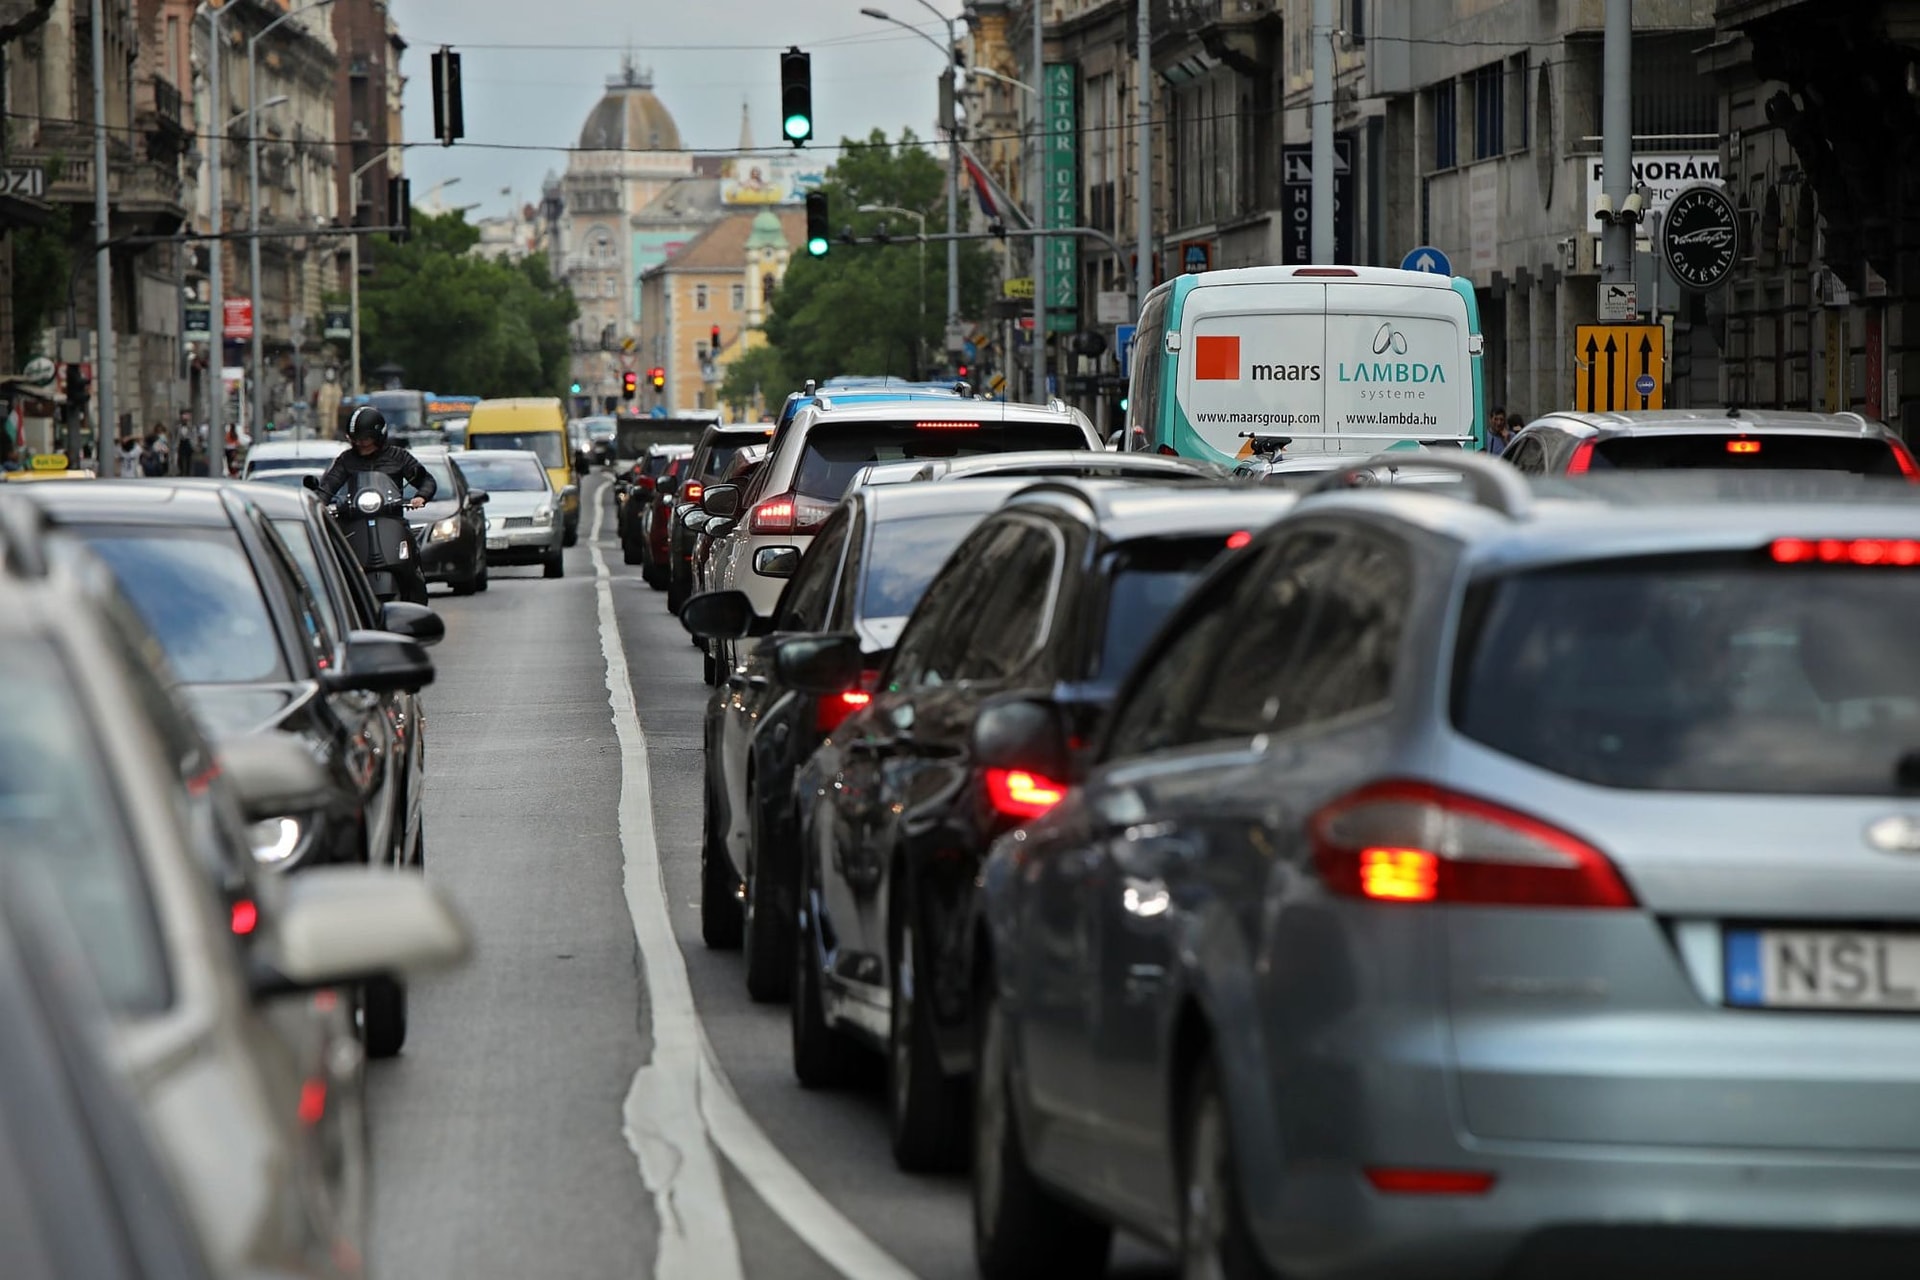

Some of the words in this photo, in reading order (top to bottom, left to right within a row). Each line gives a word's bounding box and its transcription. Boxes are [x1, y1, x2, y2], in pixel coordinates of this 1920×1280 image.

[1055, 64, 1071, 150] ASTOR
[1672, 194, 1730, 227] GALLERY
[1673, 250, 1732, 282] GALÉRIA
[1252, 364, 1320, 381] maars
[1339, 362, 1445, 383] LAMBDA
[1360, 389, 1426, 400] systeme
[1196, 412, 1320, 426] www.maarsgroup.com
[1346, 412, 1437, 425] www.lambda.hu
[1776, 933, 1915, 997] NSL
